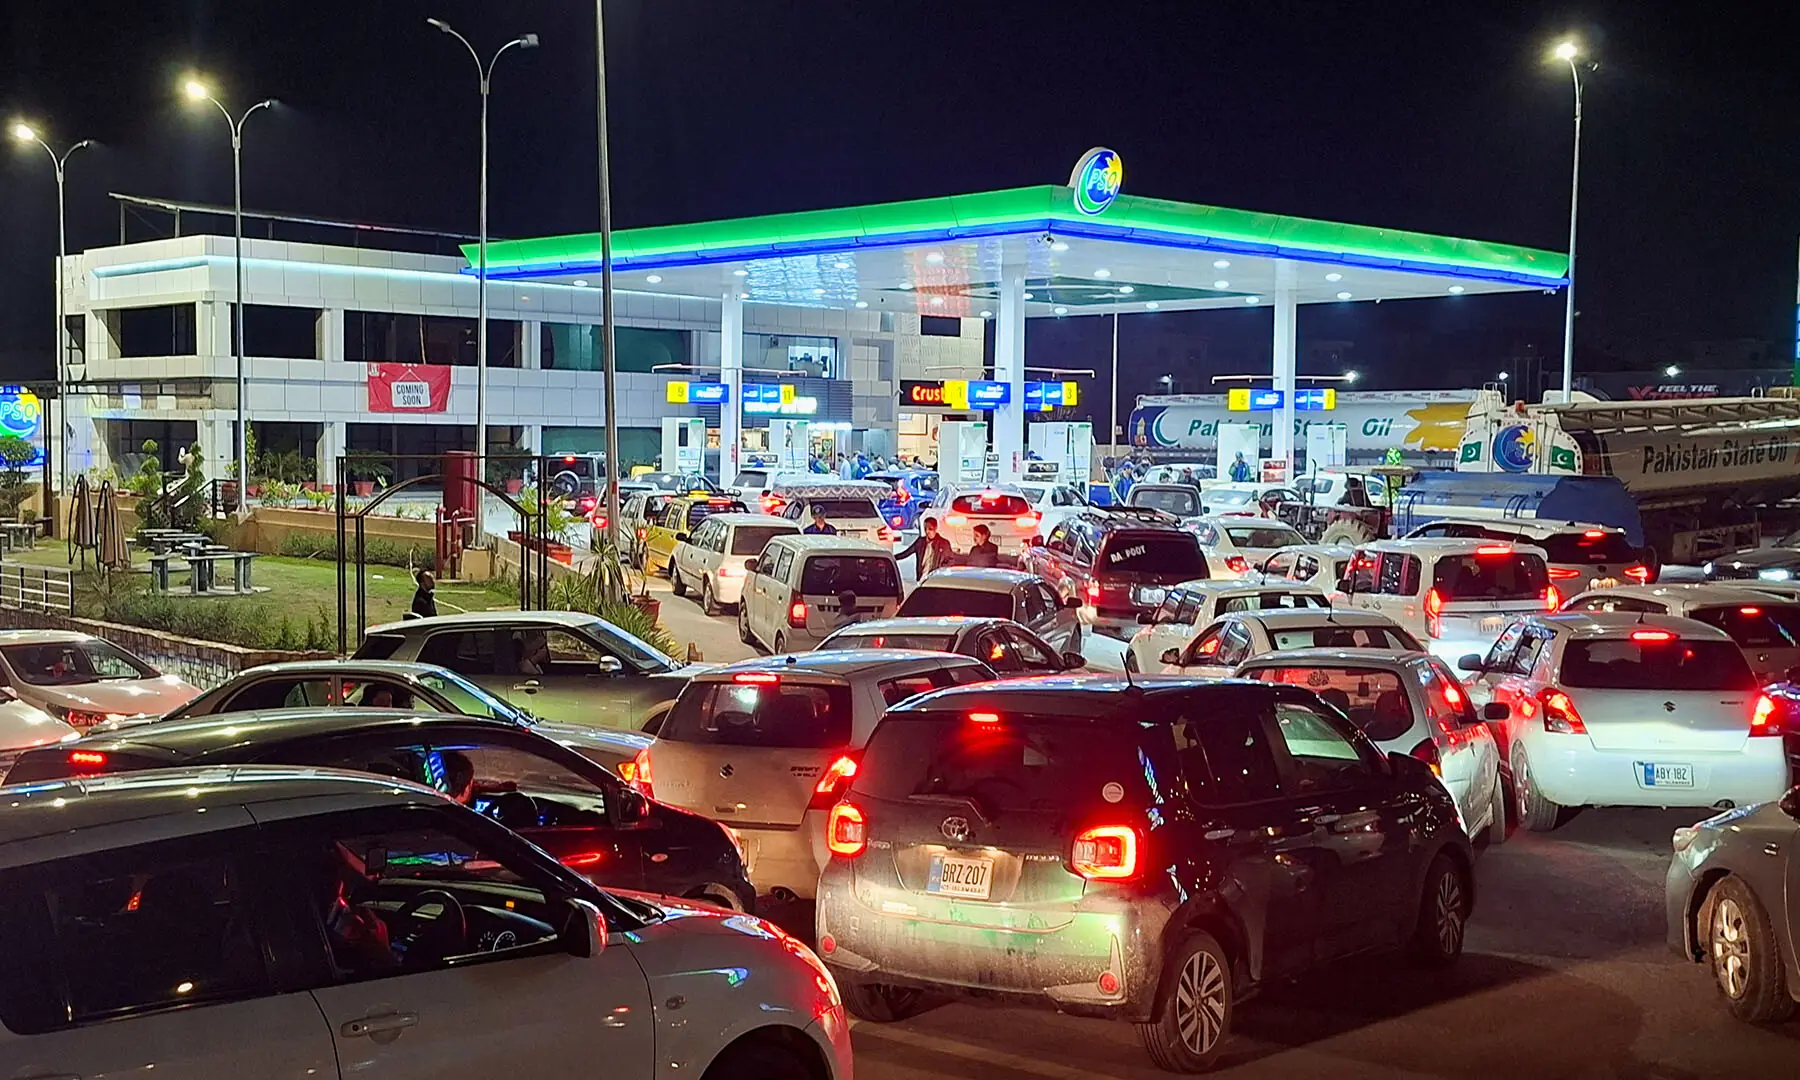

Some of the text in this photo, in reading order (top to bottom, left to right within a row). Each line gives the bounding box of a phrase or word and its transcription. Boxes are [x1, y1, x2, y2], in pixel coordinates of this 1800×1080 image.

[1087, 168, 1117, 193] PSO
[396, 384, 424, 395] COMING
[677, 386, 684, 397] 9
[783, 390, 791, 400] 11
[402, 395, 422, 405] SOON
[0, 401, 36, 421] PSO
[1362, 418, 1394, 437] Oil
[1642, 435, 1788, 474] Pakistan State Oil
[1656, 767, 1687, 780] ABY 182
[942, 863, 987, 886] BRZ 207
